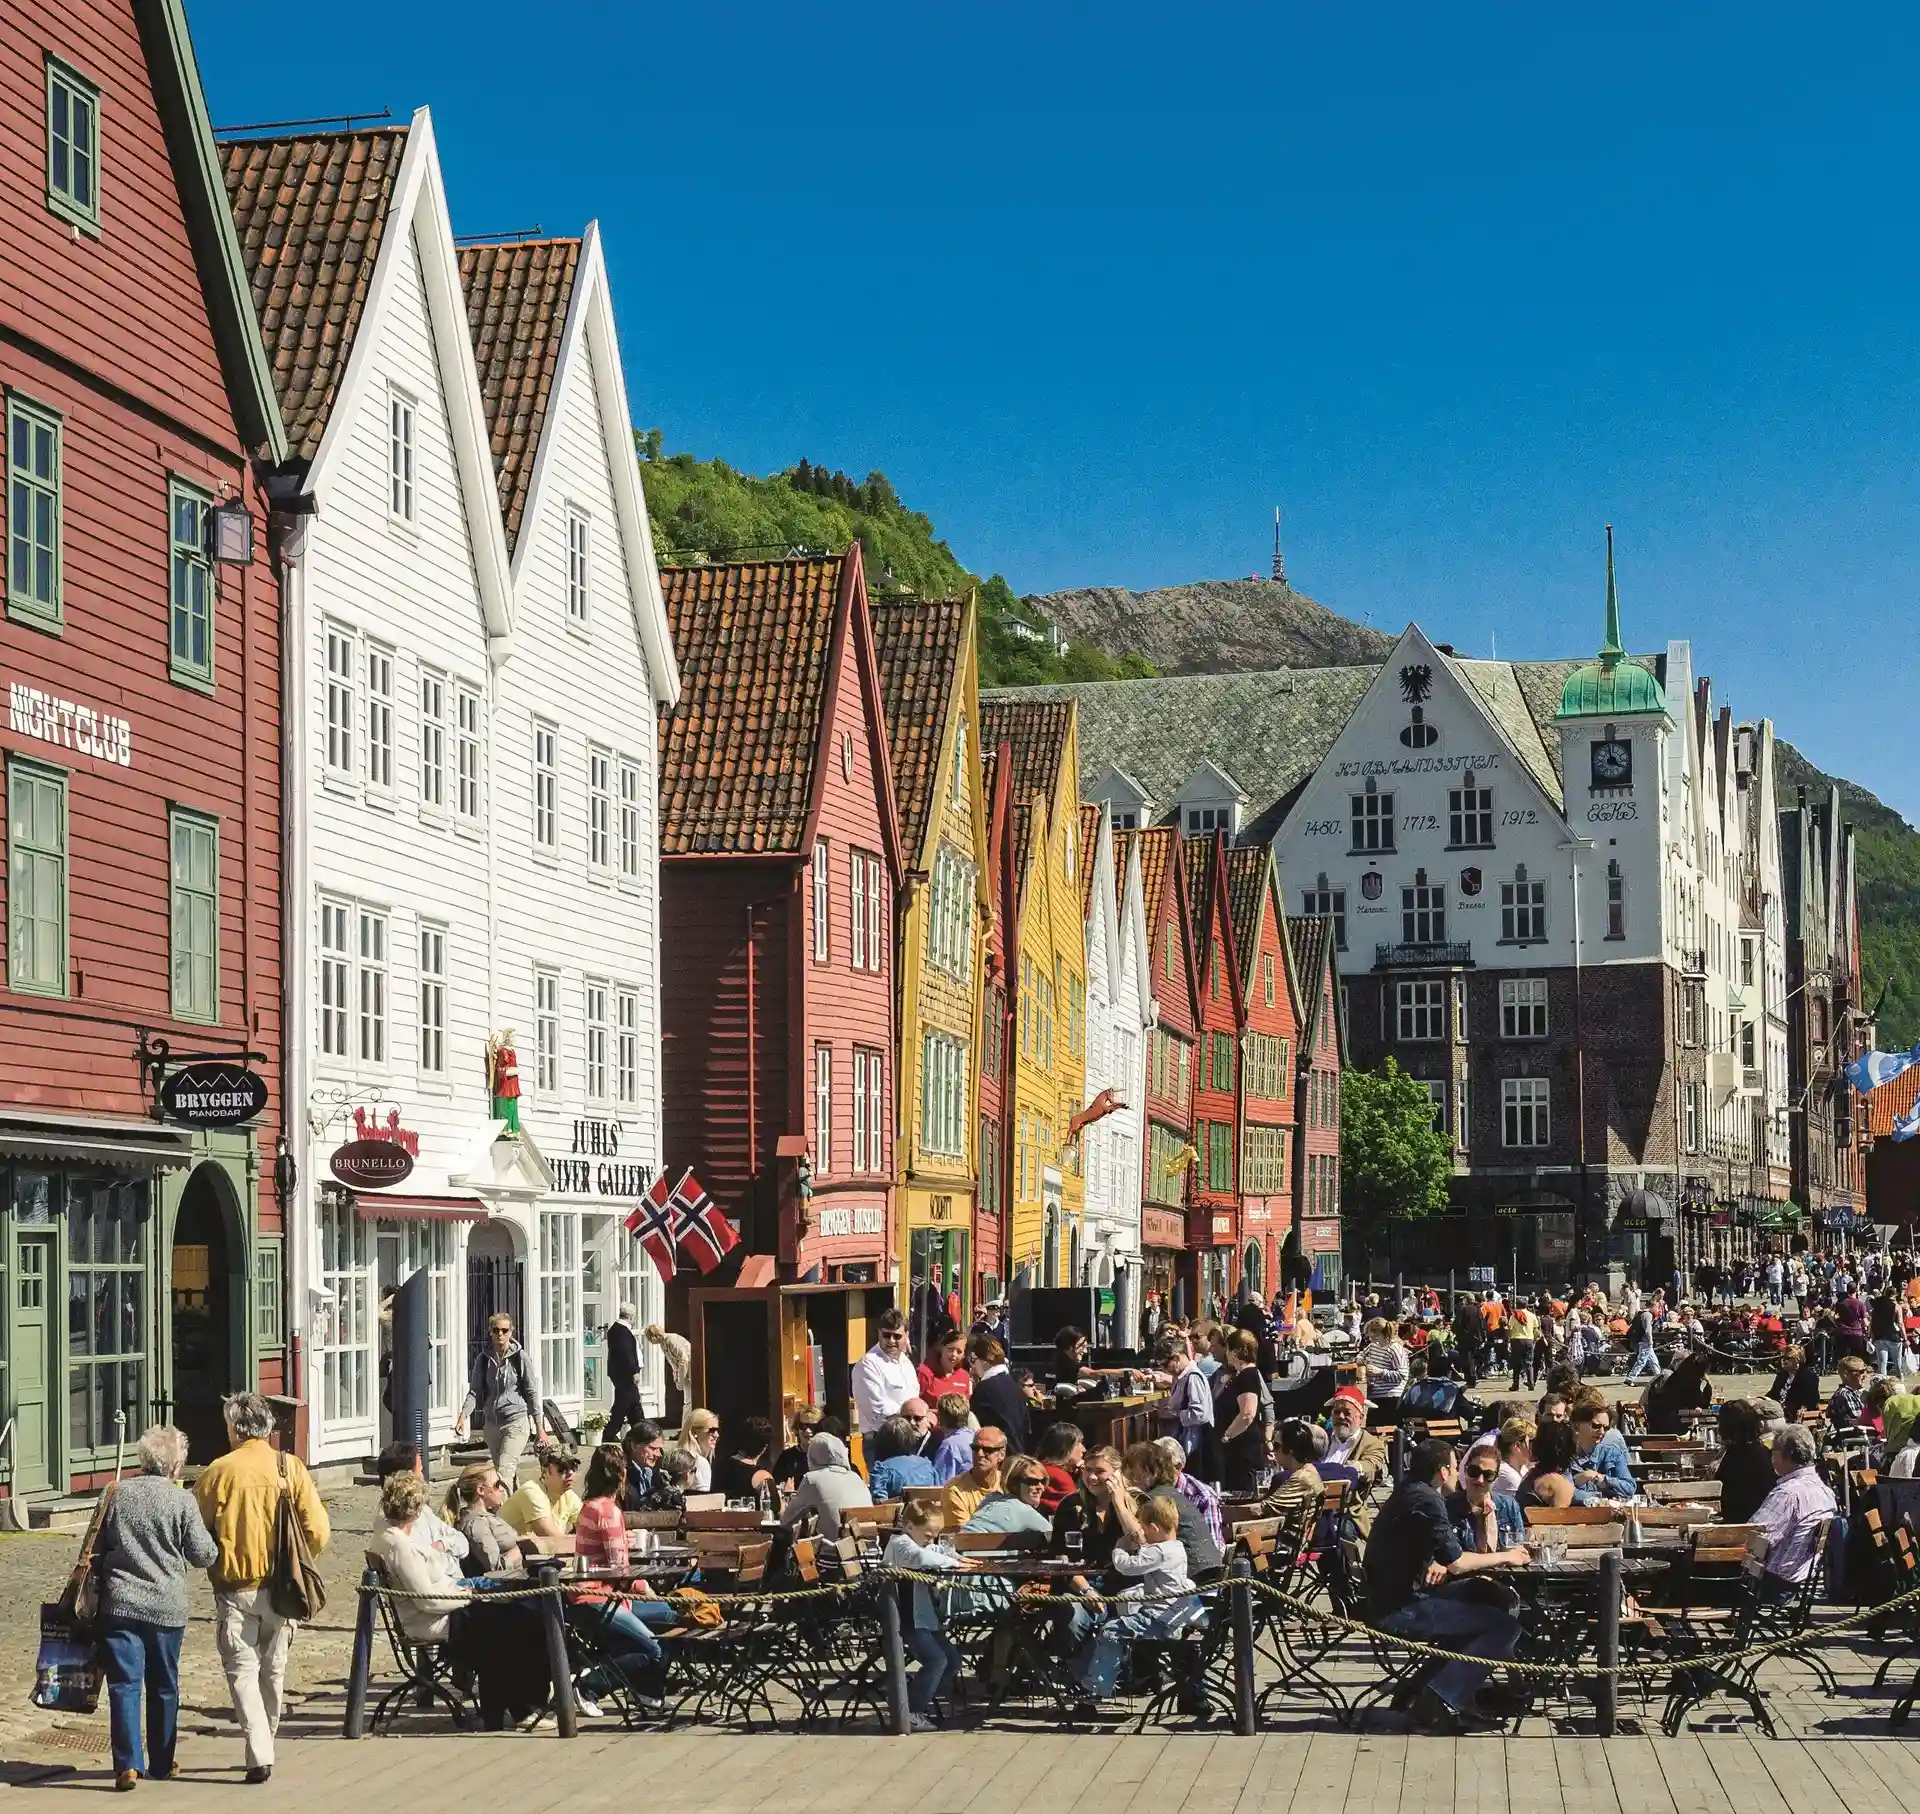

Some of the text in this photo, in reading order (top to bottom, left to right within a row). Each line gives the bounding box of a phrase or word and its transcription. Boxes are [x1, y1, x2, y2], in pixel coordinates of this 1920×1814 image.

[10, 682, 131, 767] NIGHTCLUB
[1402, 815, 1440, 831] 1712.
[1501, 810, 1539, 825] 1912.
[1304, 820, 1342, 836] 1480.
[175, 1092, 253, 1109] BRYGGEN
[189, 1109, 240, 1117] PIANOBAR
[572, 1119, 624, 1157] JUHLS'
[335, 1158, 405, 1168] BRUNELLO
[545, 1157, 591, 1193] ILVER
